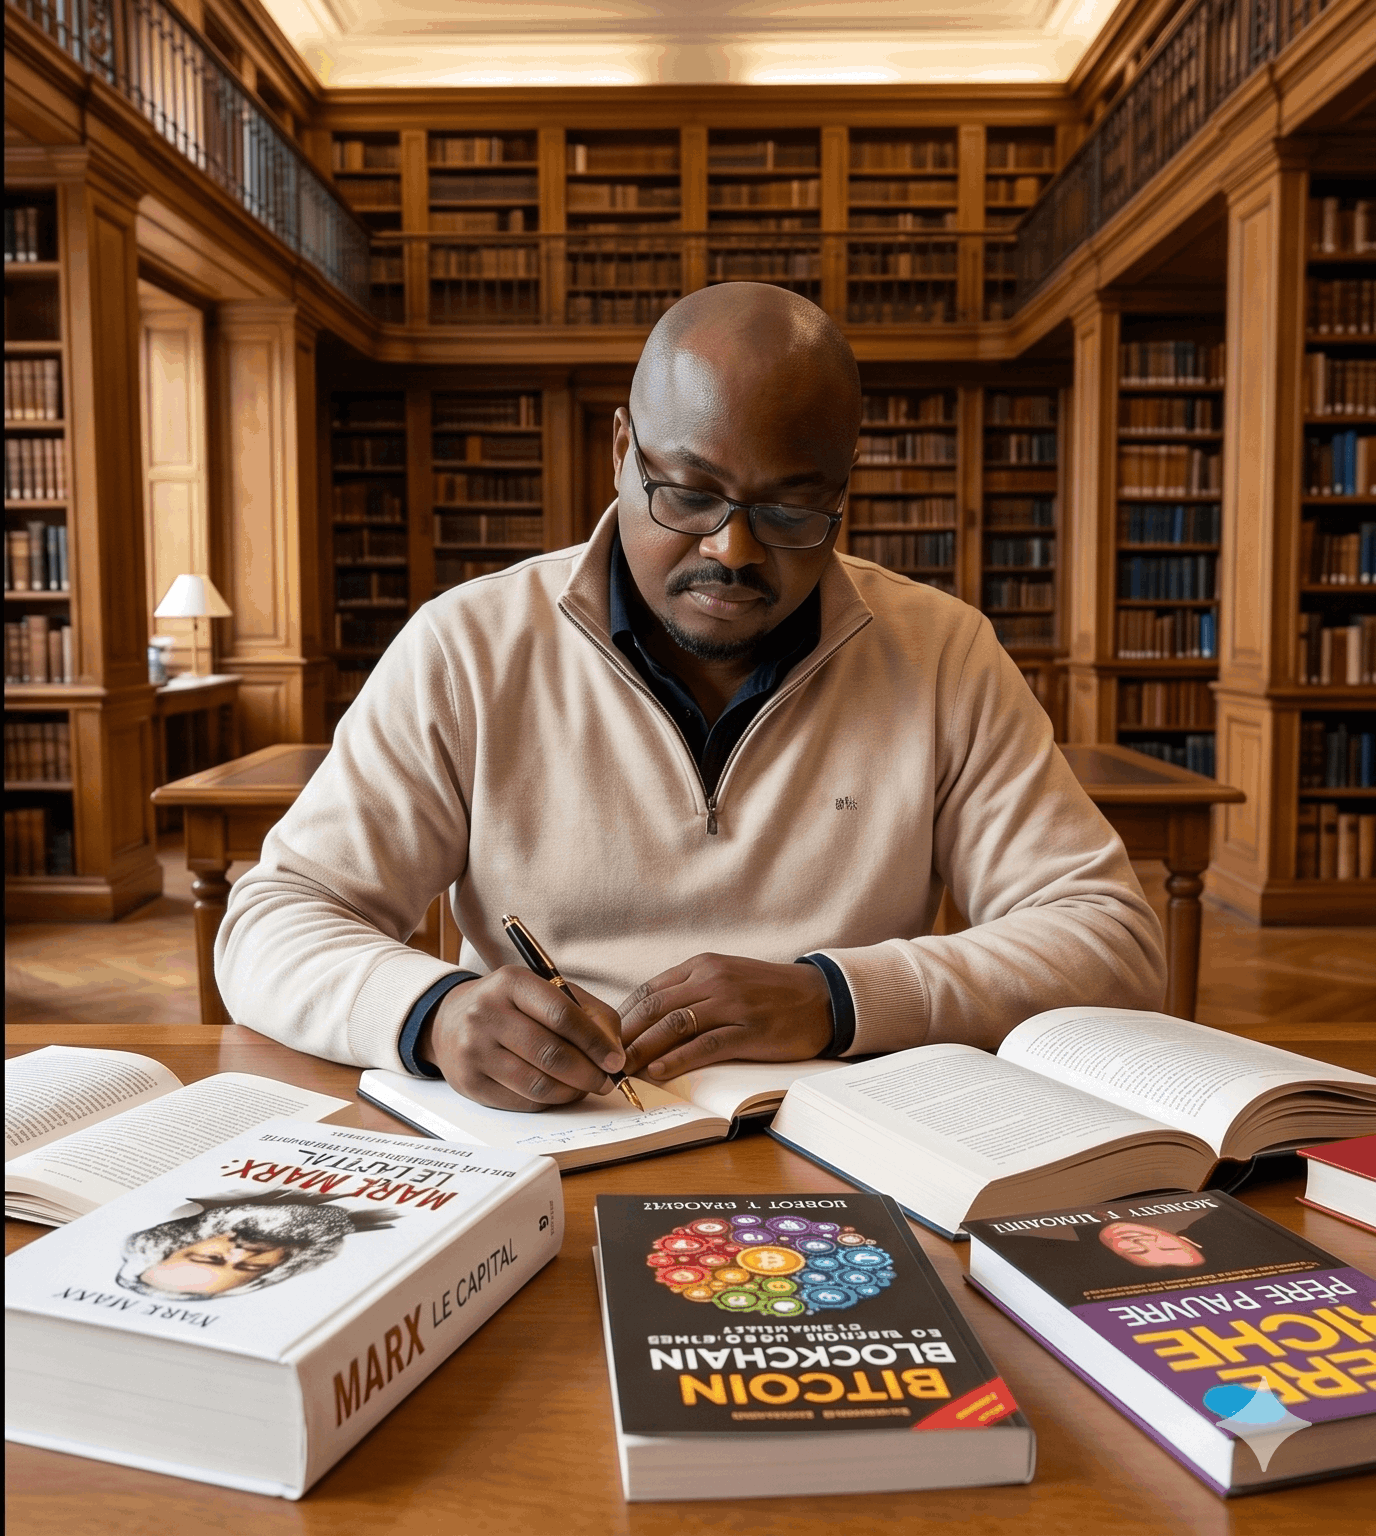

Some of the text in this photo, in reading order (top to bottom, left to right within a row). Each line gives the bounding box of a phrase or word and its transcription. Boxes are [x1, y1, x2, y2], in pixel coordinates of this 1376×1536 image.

[411, 1169, 455, 1188] LE
[1108, 1290, 1262, 1327] PAUVRE
[333, 1238, 518, 1429] MARX LE CAPITAL
[650, 1343, 957, 1371] BLOCKCHAIN
[679, 1368, 952, 1406] BITCOIN
